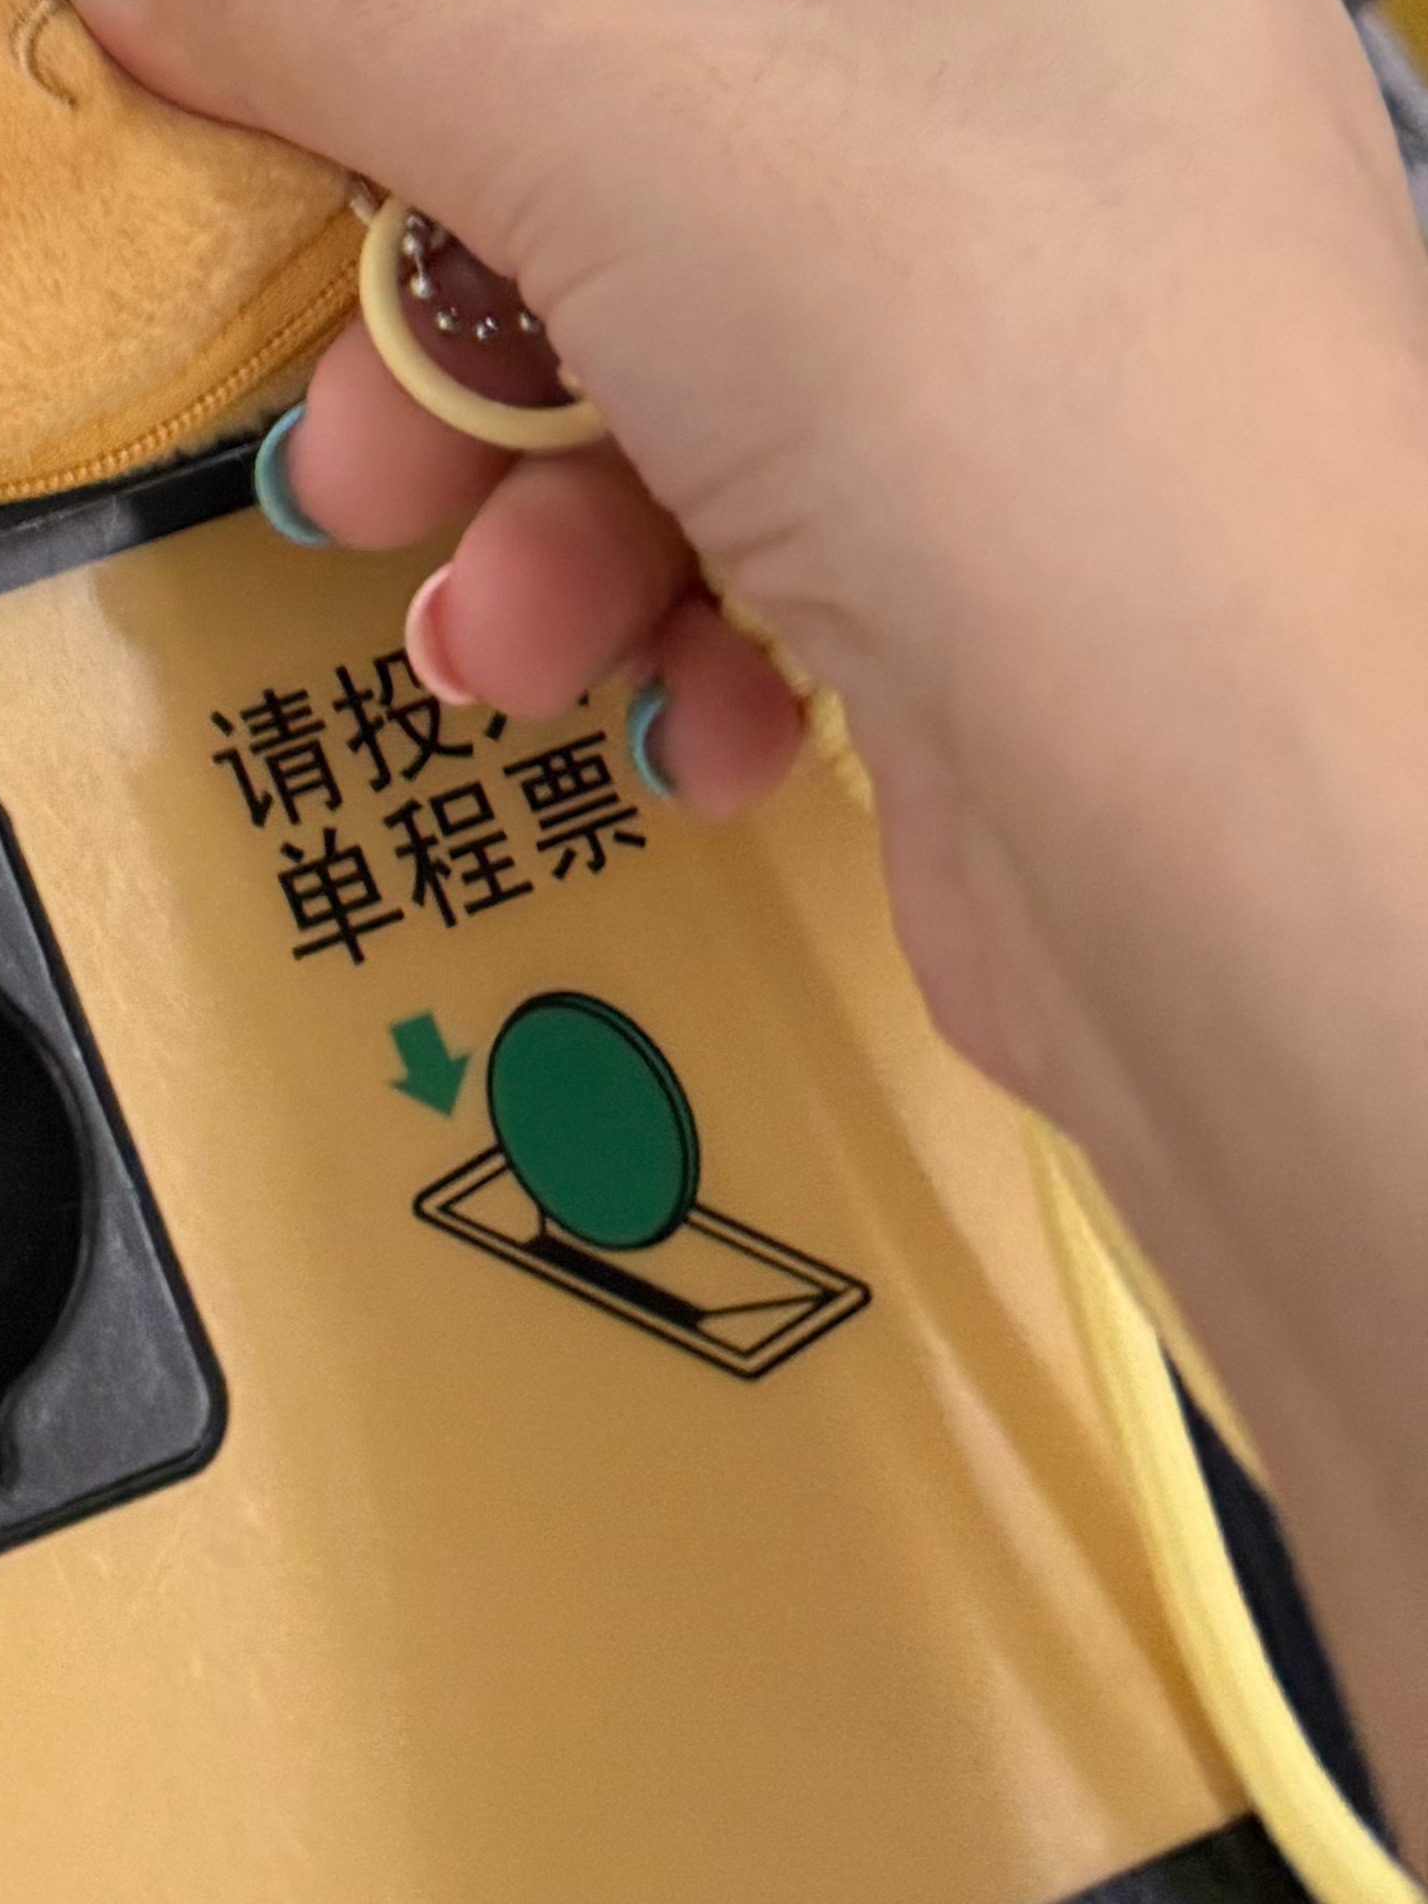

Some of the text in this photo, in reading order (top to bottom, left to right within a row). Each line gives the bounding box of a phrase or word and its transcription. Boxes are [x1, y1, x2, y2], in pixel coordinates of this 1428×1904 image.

[210, 647, 591, 828] 请投
[277, 730, 648, 967] 单程票
